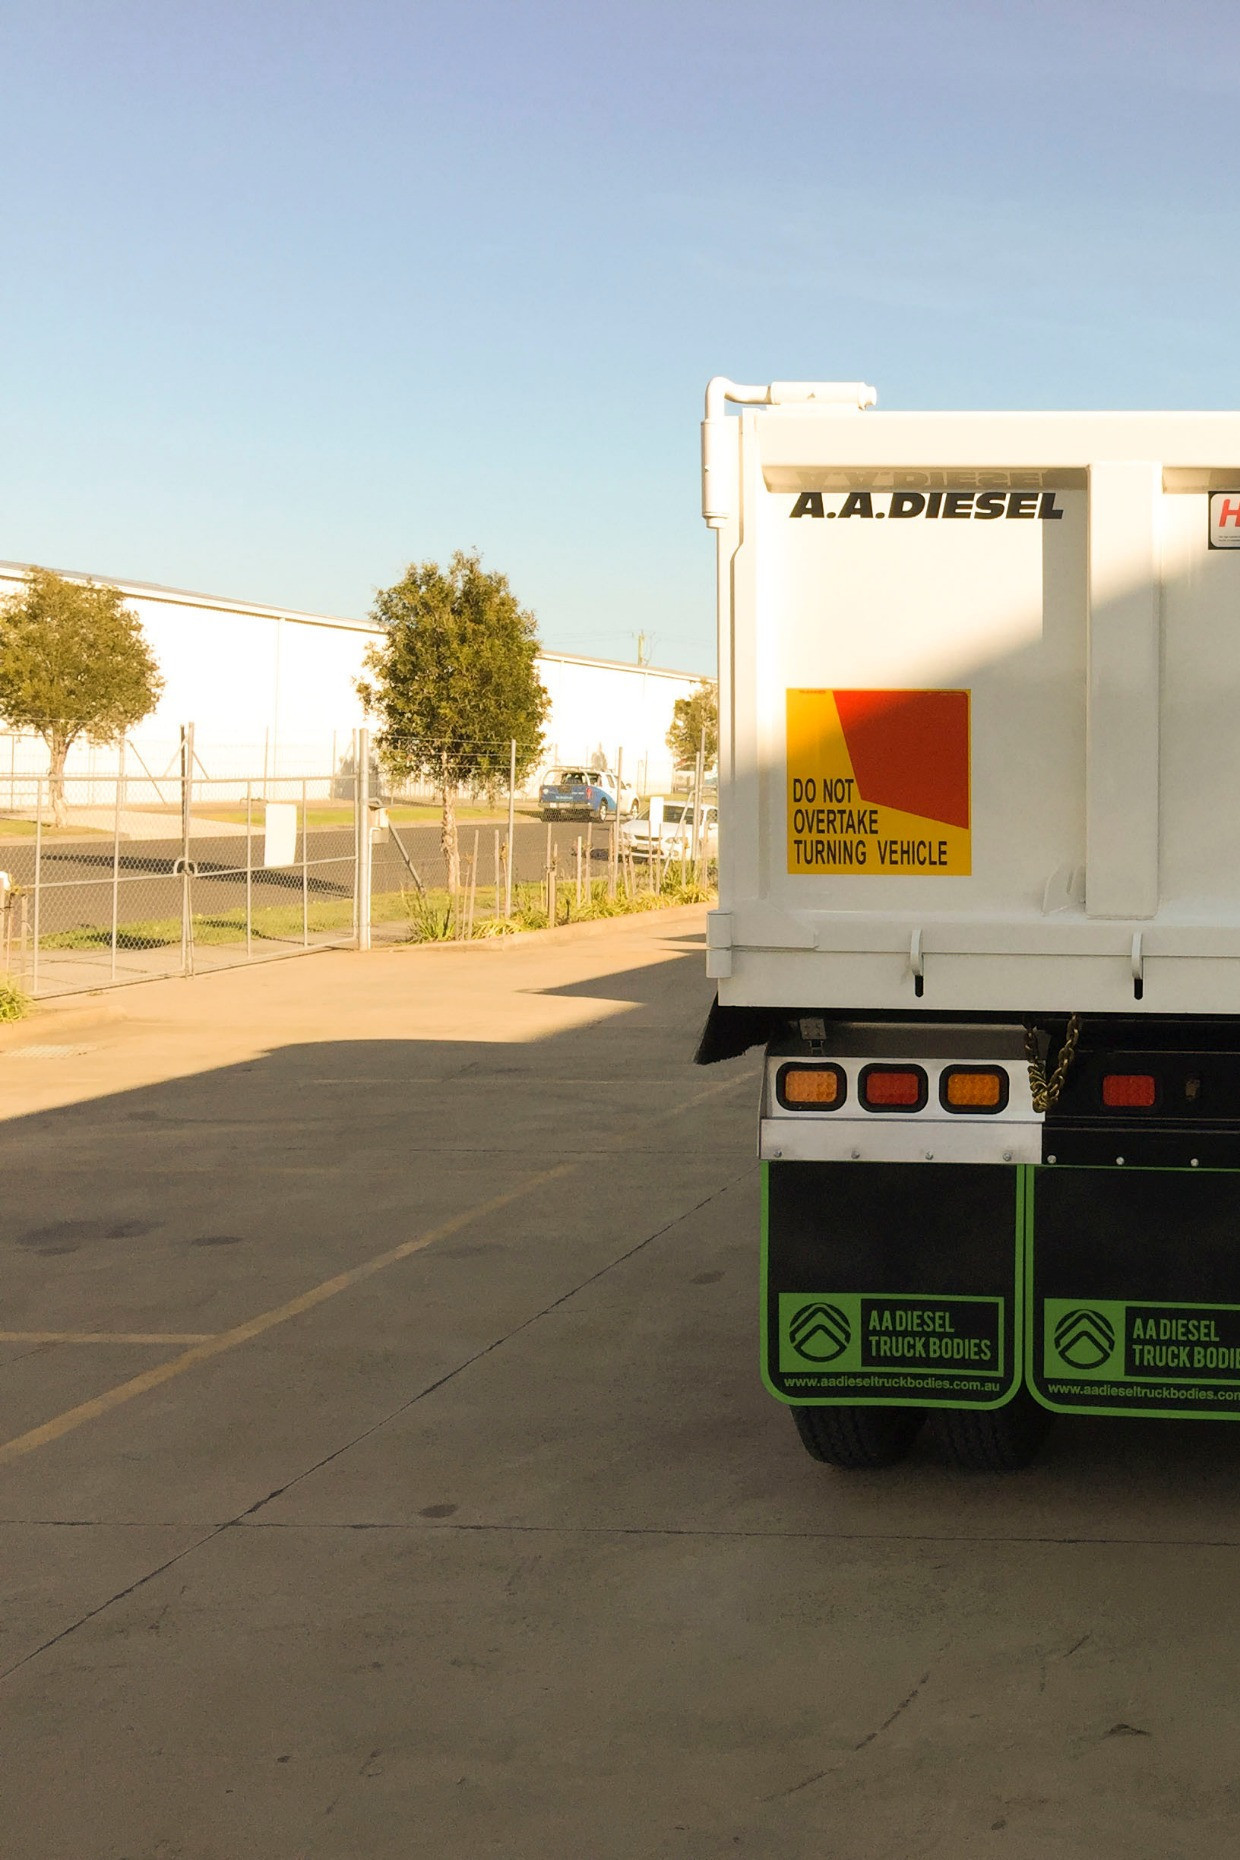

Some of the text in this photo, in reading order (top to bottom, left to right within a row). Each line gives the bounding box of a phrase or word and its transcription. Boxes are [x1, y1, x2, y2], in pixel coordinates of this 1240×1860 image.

[789, 491, 1064, 520] A.A.DIESEL
[793, 778, 854, 803] DO NOT
[794, 809, 879, 834] OVERTAKE
[794, 839, 948, 866] TURNING VEHICLE
[896, 1311, 954, 1332] DIESEL
[1160, 1319, 1220, 1341] DIESEL
[869, 1336, 991, 1360] TRUCK BODIES
[1133, 1345, 1193, 1367] TRUCK
[784, 1376, 1000, 1391] www.aadieseltruckbodies.com.au
